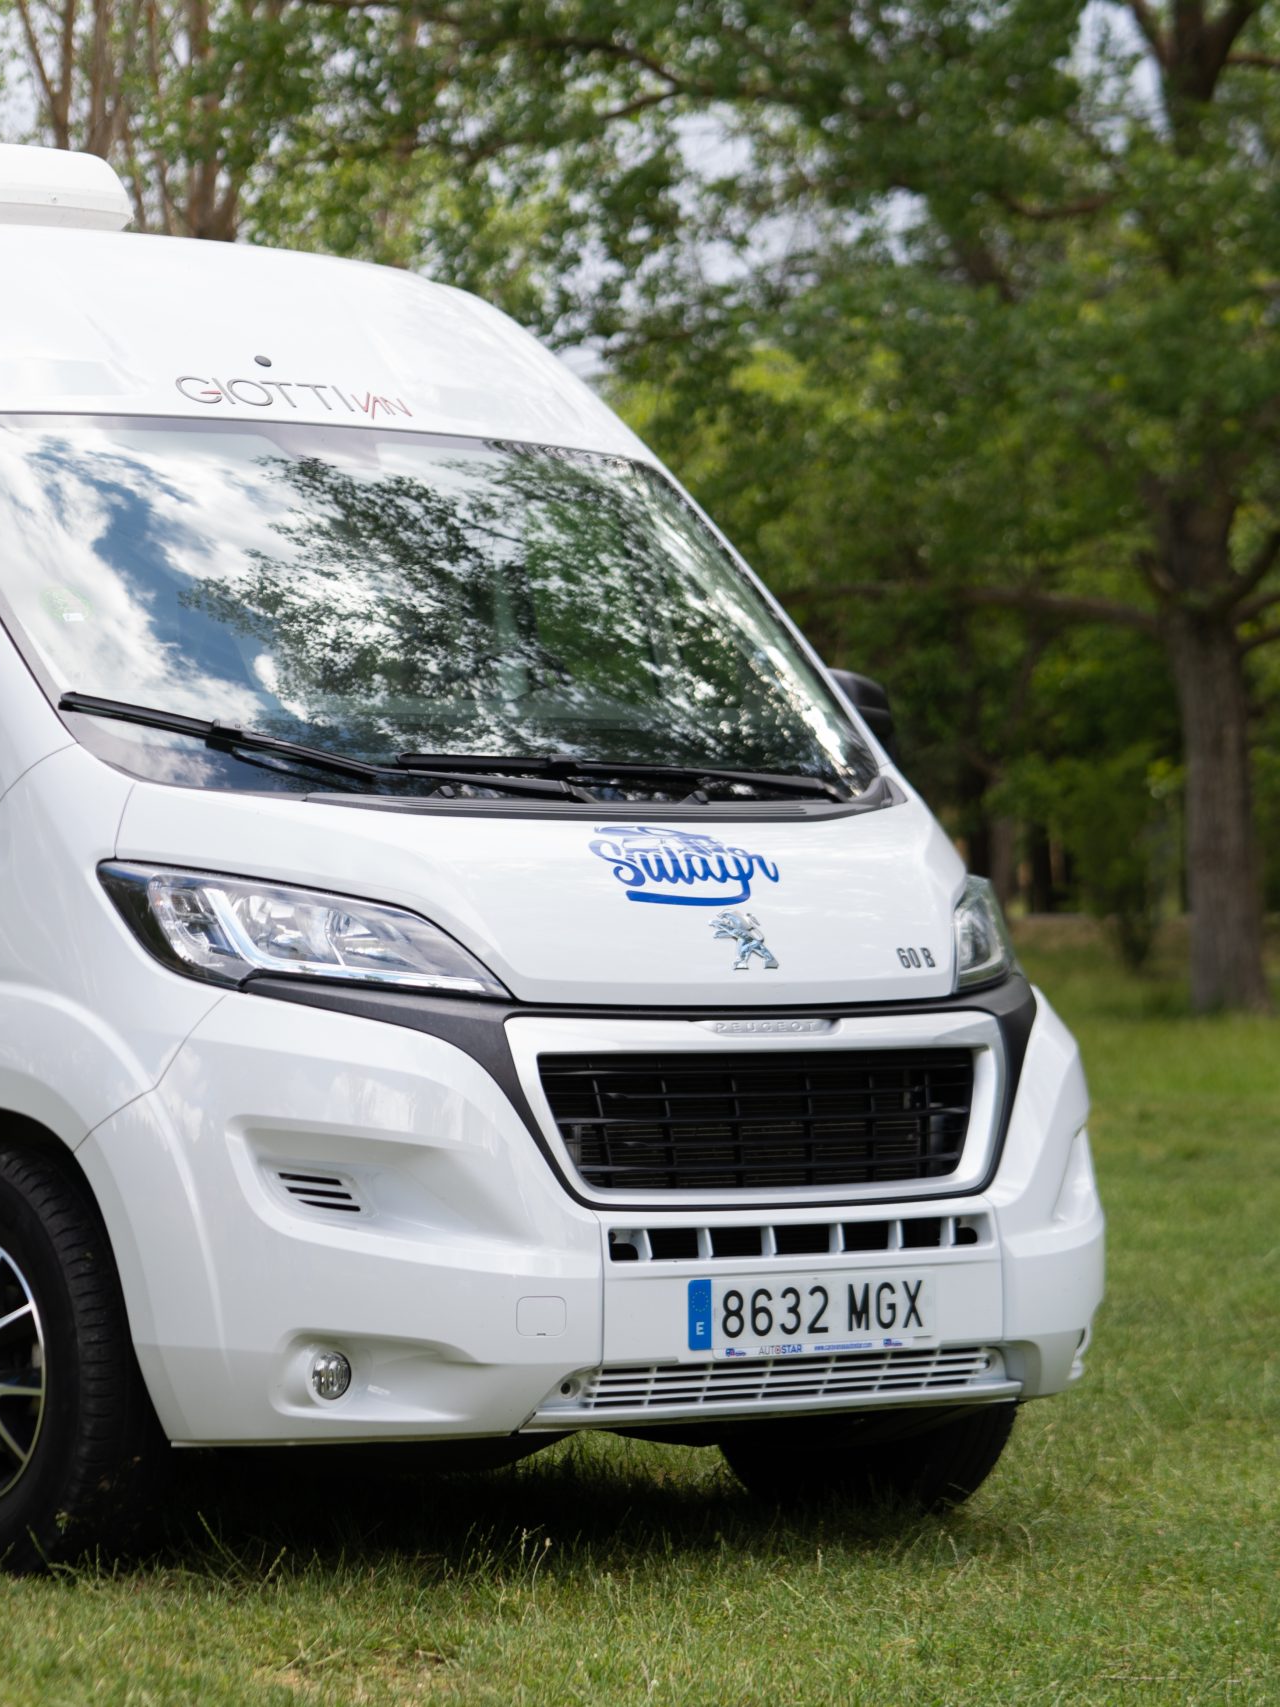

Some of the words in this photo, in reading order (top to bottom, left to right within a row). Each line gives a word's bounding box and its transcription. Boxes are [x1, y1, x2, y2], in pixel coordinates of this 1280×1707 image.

[588, 839, 779, 906] Sulayr
[896, 947, 921, 969] 60
[919, 947, 936, 968] B
[716, 1022, 816, 1033] PEUGEOT
[722, 1285, 829, 1338] 8632
[848, 1280, 923, 1332] MGX
[696, 1321, 705, 1336] E
[758, 1343, 803, 1356] AUTOSTAR
